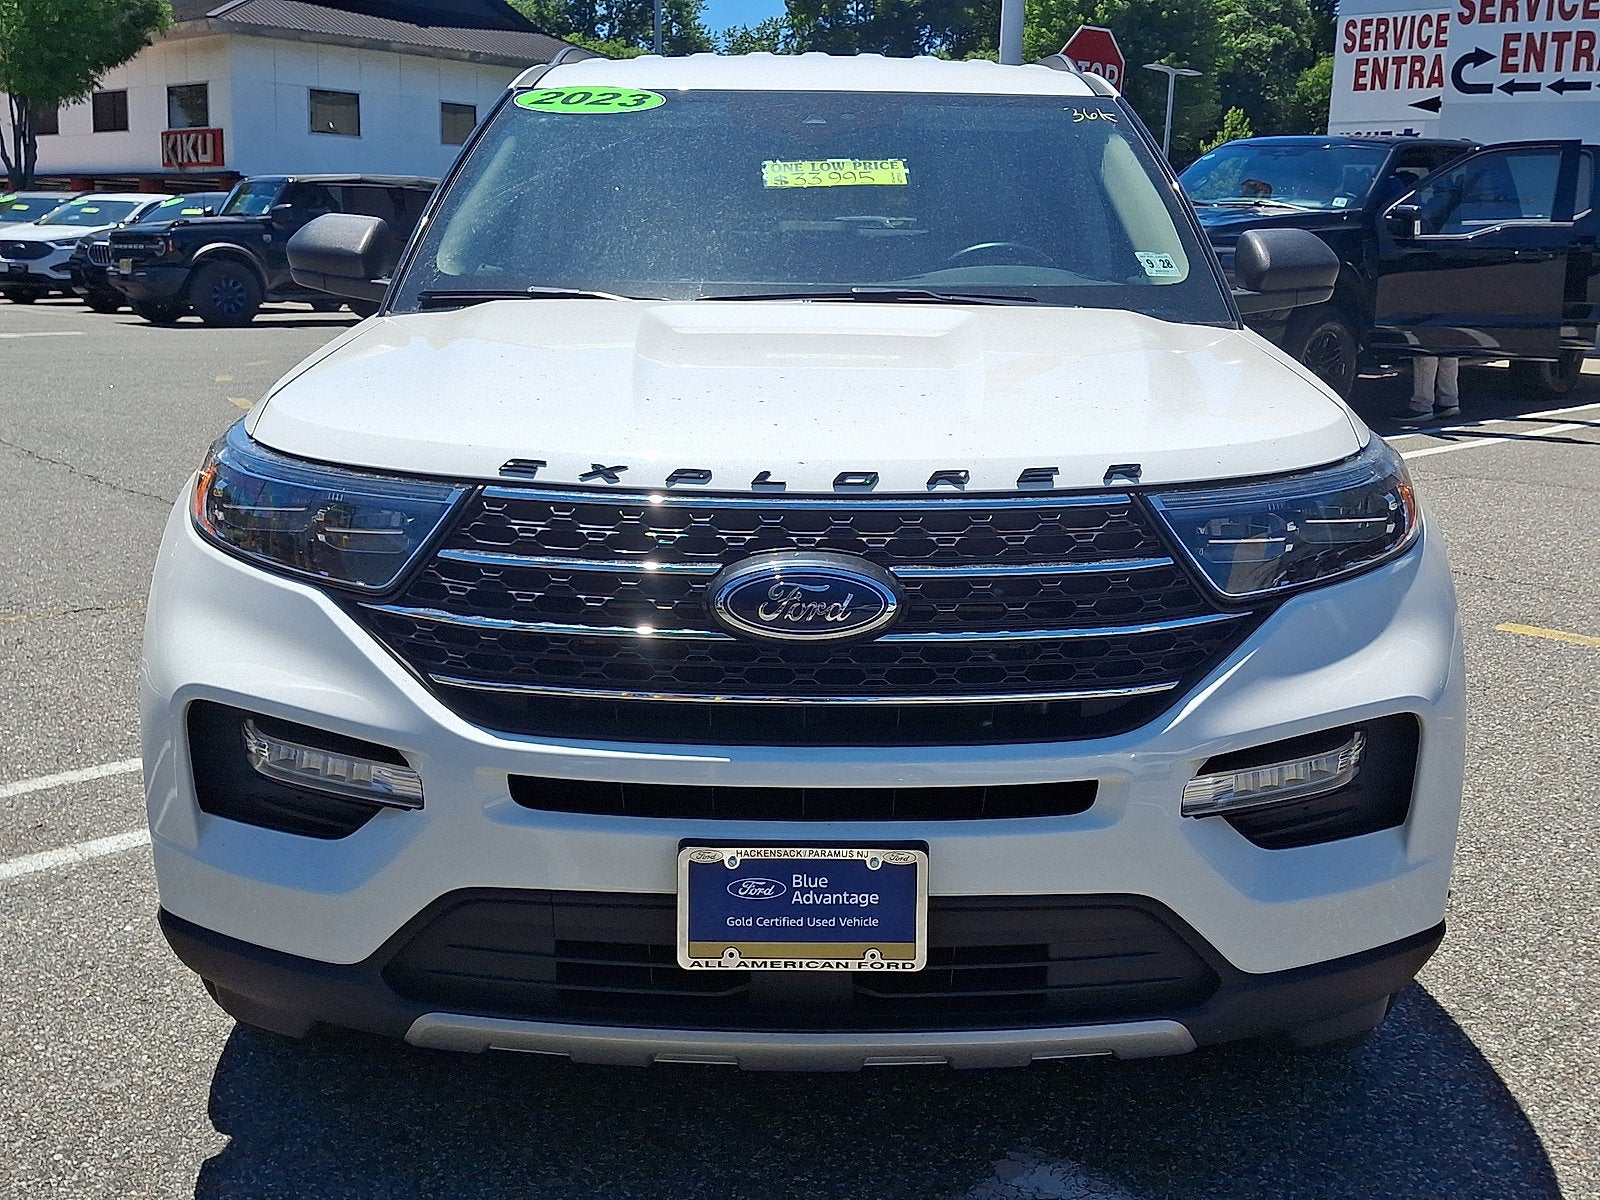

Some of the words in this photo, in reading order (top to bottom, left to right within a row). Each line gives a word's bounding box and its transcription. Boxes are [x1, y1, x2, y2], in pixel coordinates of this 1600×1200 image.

[1343, 13, 1449, 53] SERVICE
[1500, 30, 1600, 74] ENTR
[529, 91, 652, 107] 2023
[163, 133, 213, 170] KIKU
[770, 162, 804, 173] ONE
[811, 162, 845, 172] LOW
[853, 161, 899, 171] PRICE
[1145, 259, 1154, 268] 9
[1158, 259, 1173, 268] 28
[498, 457, 1142, 493] EXPLORER
[758, 581, 853, 622] Ford
[696, 851, 717, 860] Ford
[889, 853, 910, 862] Ford
[738, 881, 775, 896] Ford
[792, 874, 828, 888] Blue
[791, 891, 879, 907] Advantage
[726, 916, 753, 927] Gold
[756, 916, 804, 927] Certified
[807, 917, 836, 927] Used
[839, 917, 879, 927] Vehicle
[689, 960, 729, 968] ALL
[735, 960, 849, 968] AMERICAN
[857, 961, 916, 969] FORD
